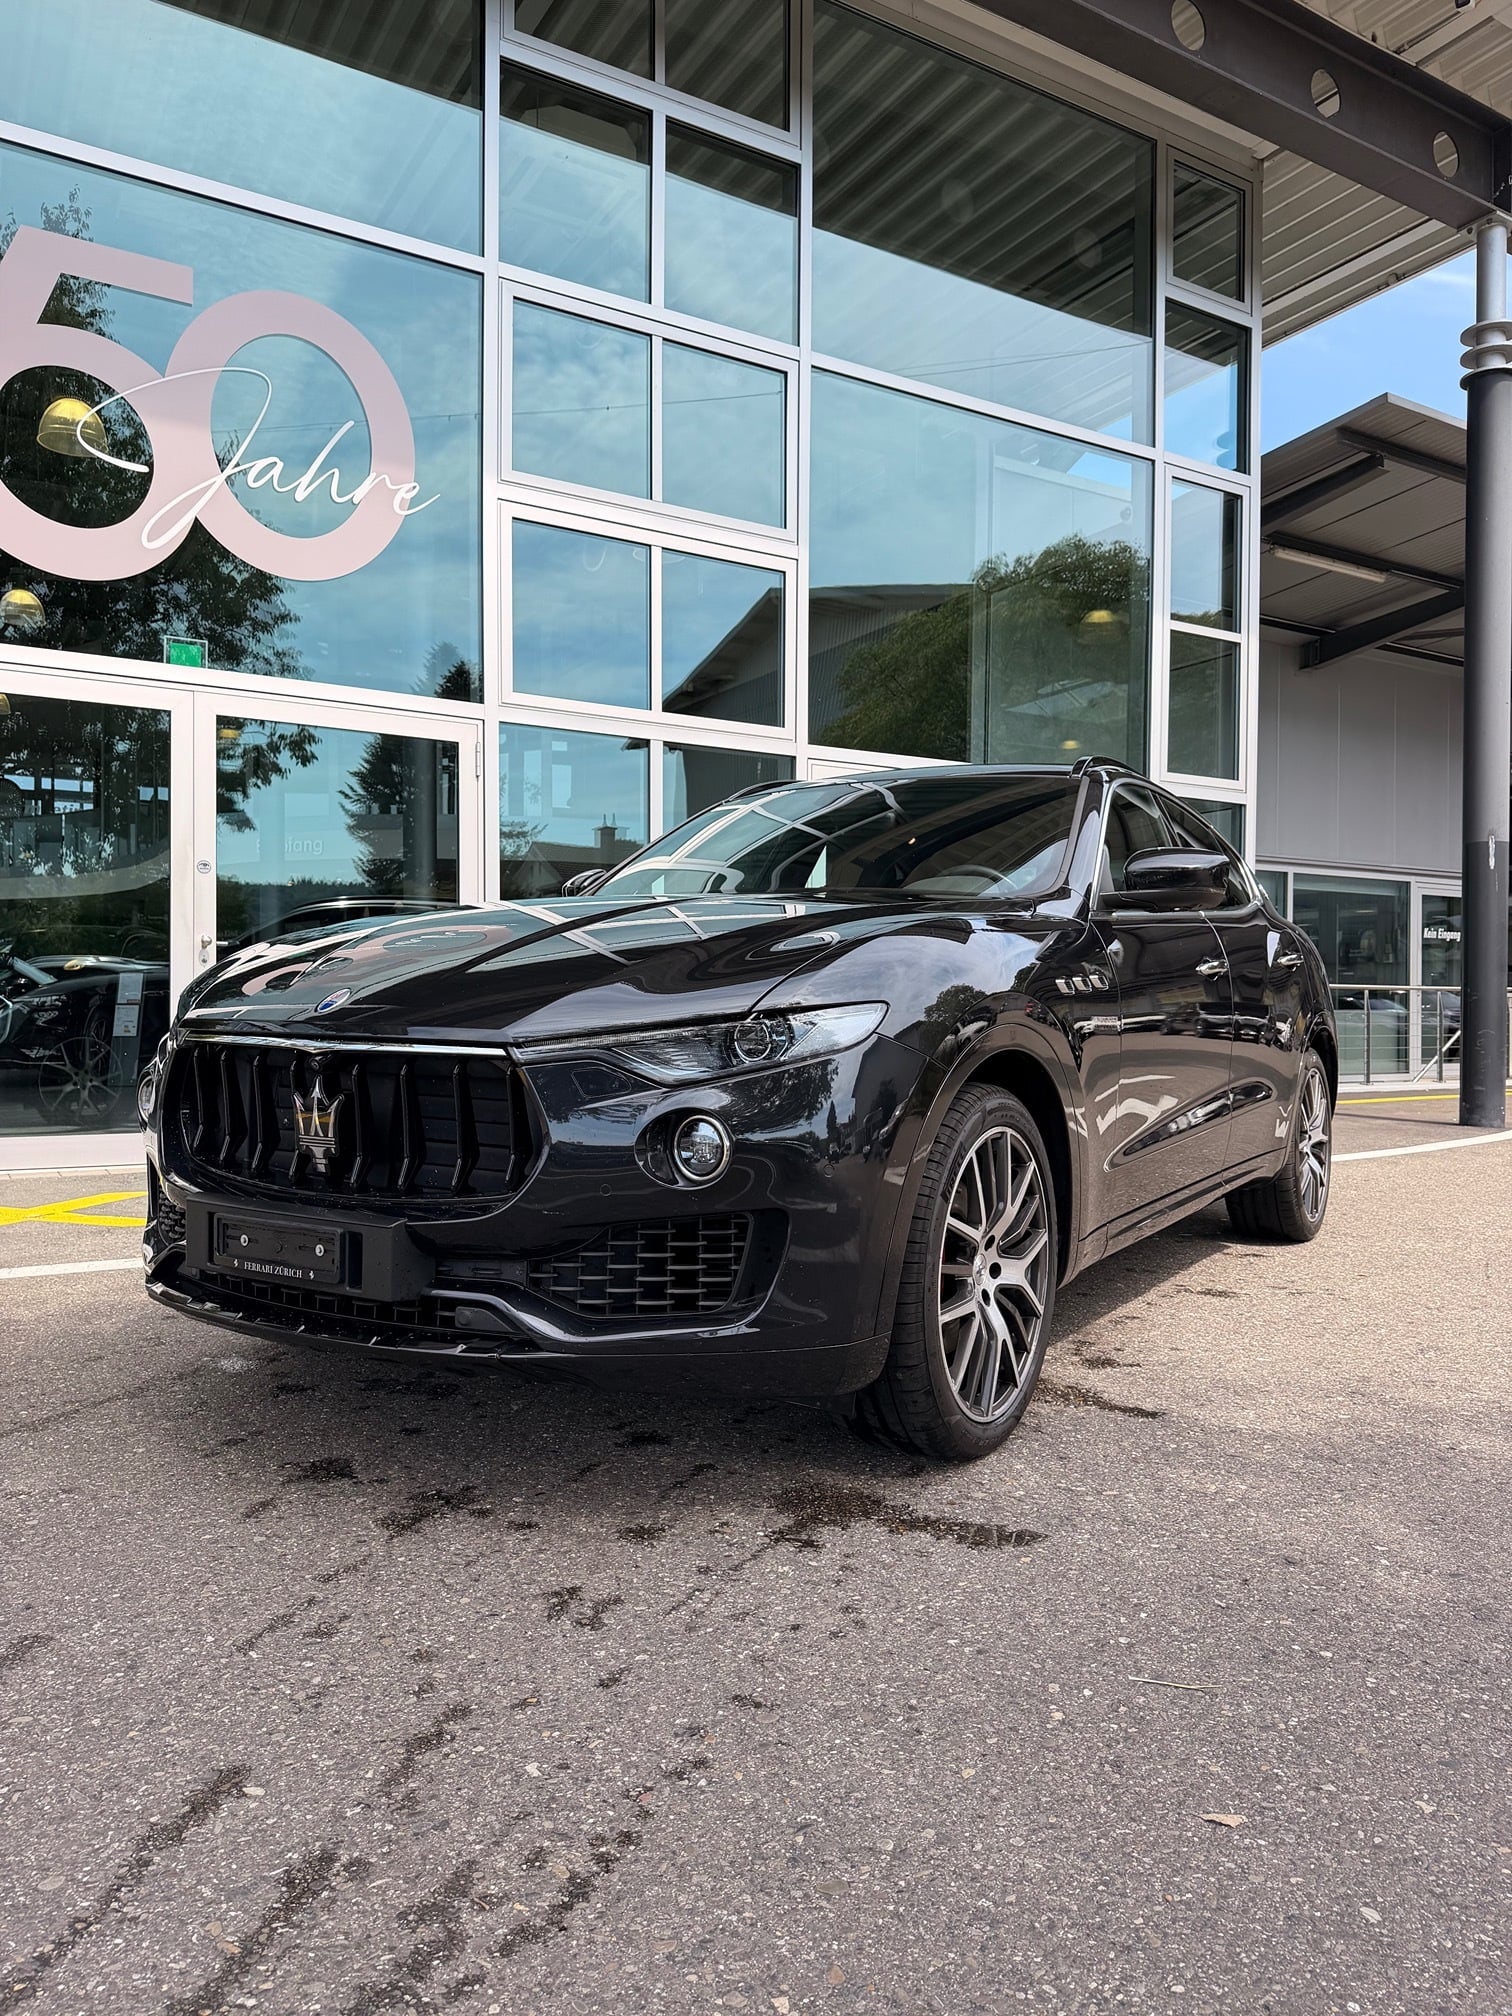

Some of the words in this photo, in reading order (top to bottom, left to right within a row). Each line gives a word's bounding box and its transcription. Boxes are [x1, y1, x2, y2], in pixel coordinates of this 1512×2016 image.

[0, 224, 416, 581] 50
[76, 367, 441, 549] Jahre
[1423, 927, 1437, 939] Kein
[1438, 927, 1461, 942] Eingang
[244, 1261, 273, 1274] FERRARI
[274, 1265, 302, 1278] ZÜRICH
